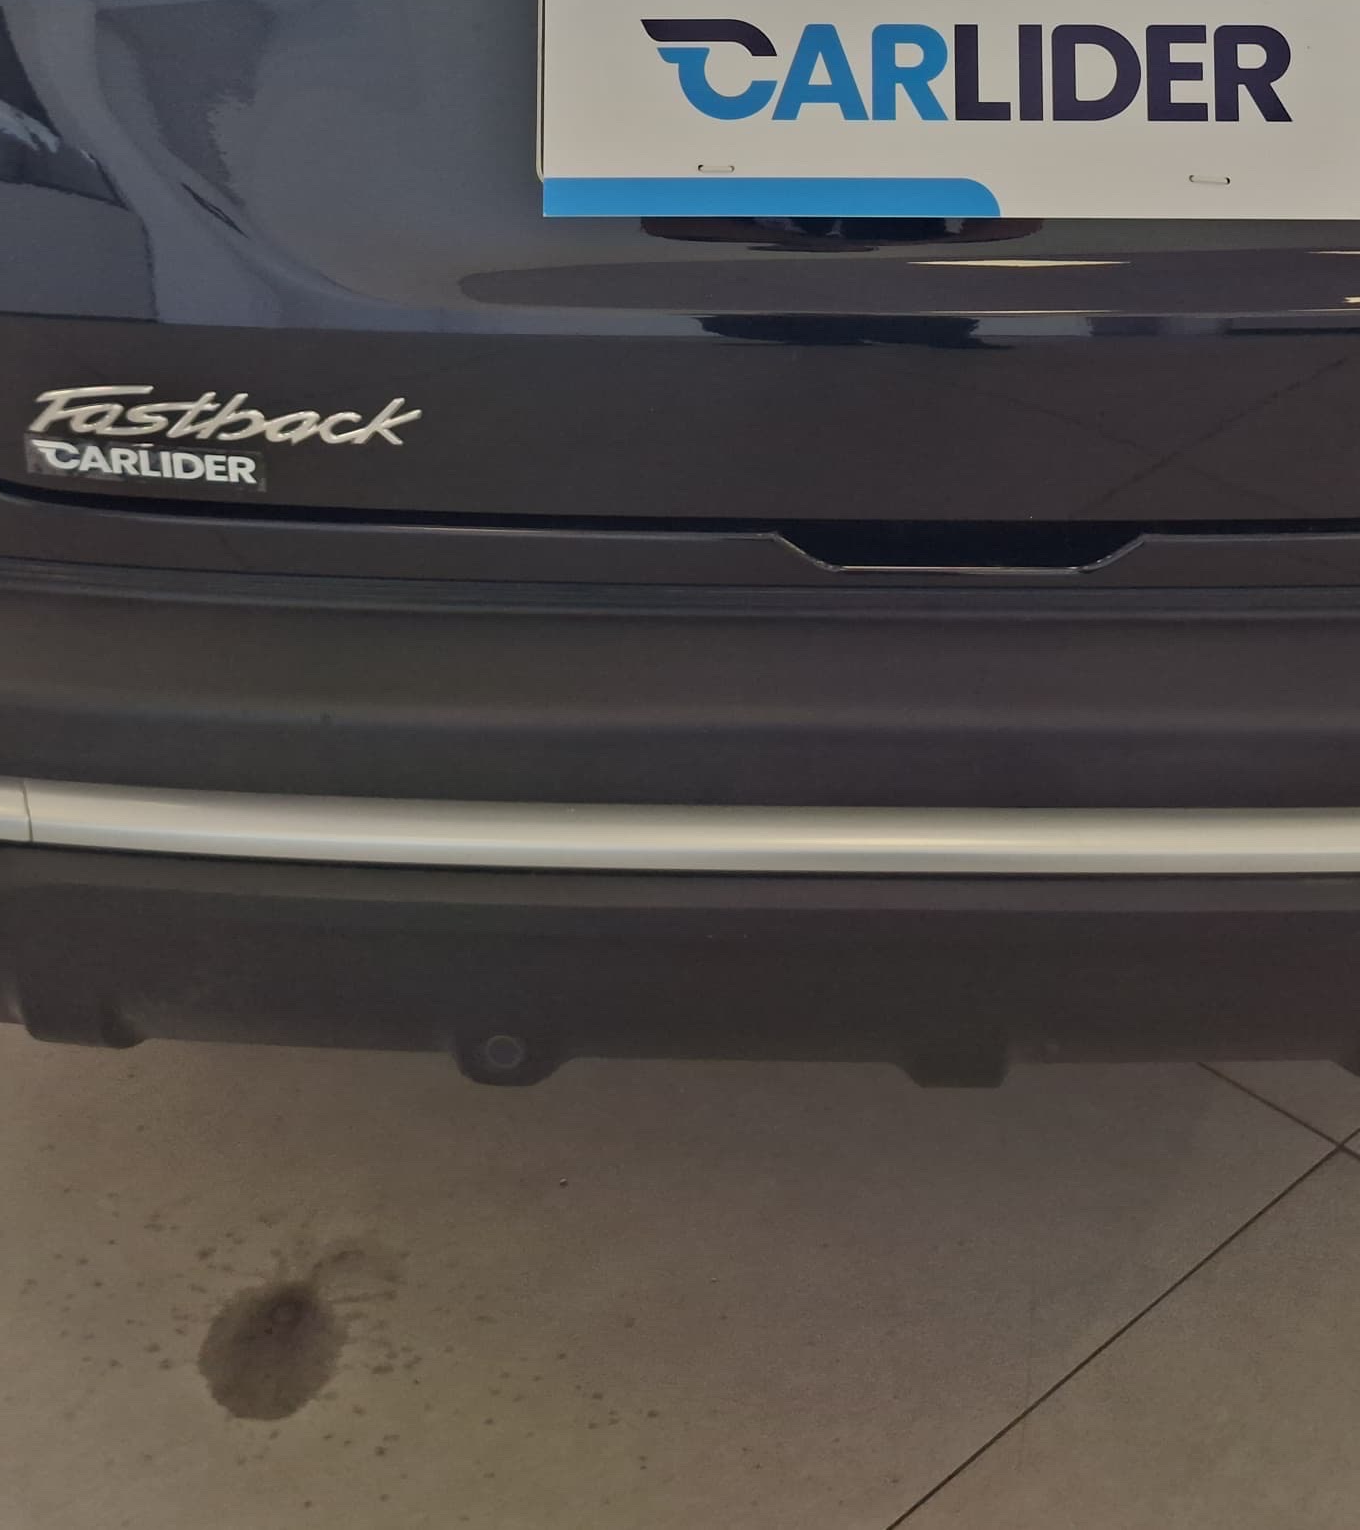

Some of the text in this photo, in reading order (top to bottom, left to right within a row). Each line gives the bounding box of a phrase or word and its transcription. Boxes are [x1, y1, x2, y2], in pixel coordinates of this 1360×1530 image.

[640, 19, 1293, 122] CARLIDER
[29, 385, 423, 446] Fastback
[31, 439, 258, 484] CARLIDER
